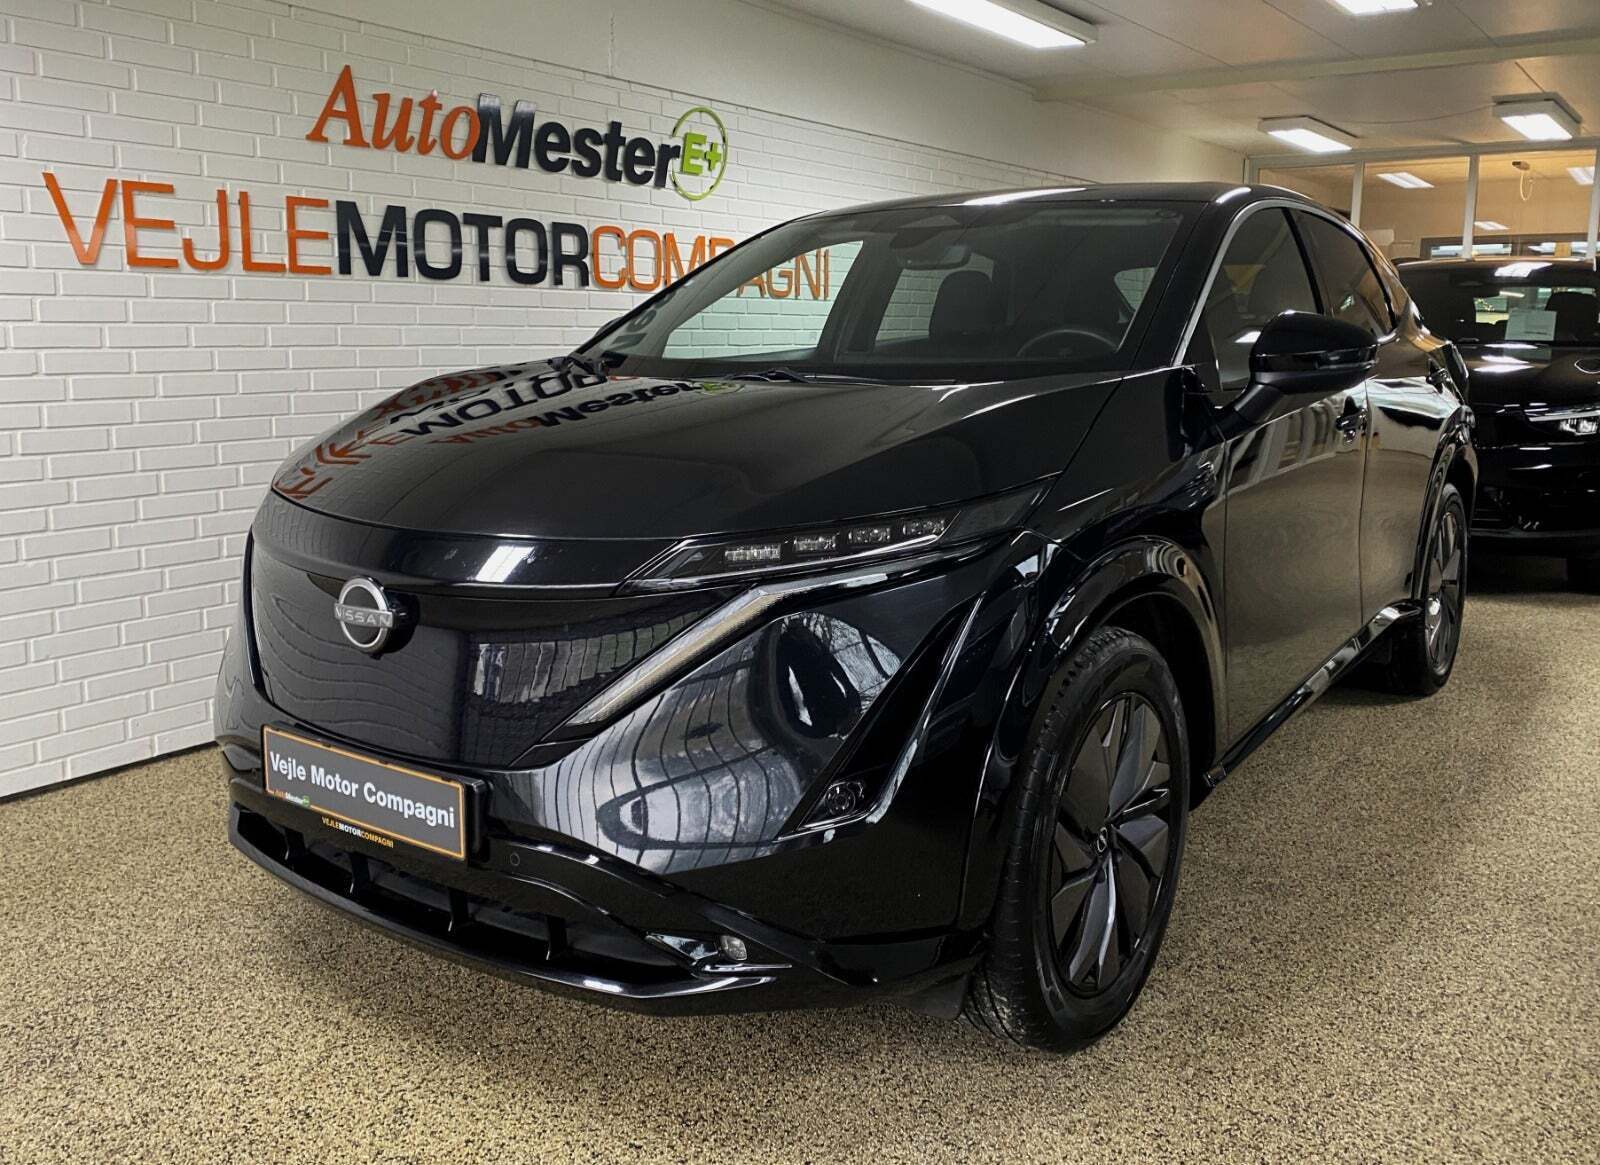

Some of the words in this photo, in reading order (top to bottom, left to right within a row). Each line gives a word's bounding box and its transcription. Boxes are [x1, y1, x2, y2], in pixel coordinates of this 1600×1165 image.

[305, 65, 681, 188] AutoMester
[335, 604, 392, 627] NISSAN
[270, 751, 306, 781] Vejle
[311, 765, 359, 798] Motor
[363, 782, 455, 828] Compagni
[321, 816, 394, 849] VEJLEMOTORCOMPAGNI
